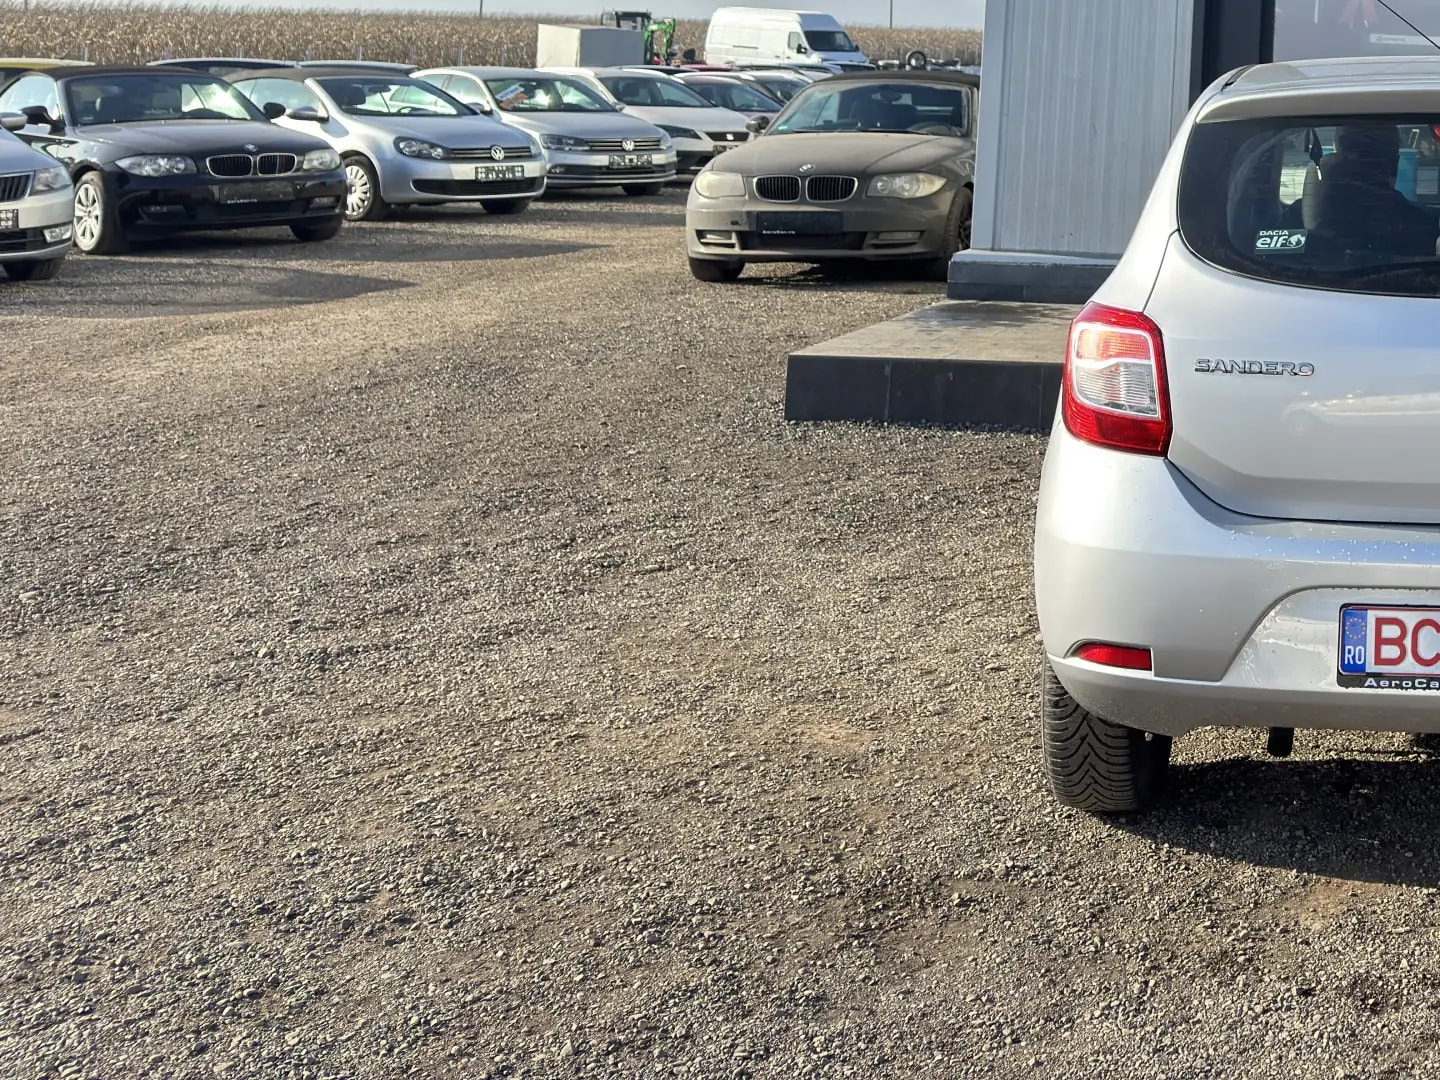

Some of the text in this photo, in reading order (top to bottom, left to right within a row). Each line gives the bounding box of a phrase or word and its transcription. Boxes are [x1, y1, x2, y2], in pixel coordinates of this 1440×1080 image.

[1256, 236, 1289, 248] elf
[1193, 358, 1315, 377] SANDERO
[1344, 645, 1365, 666] RO
